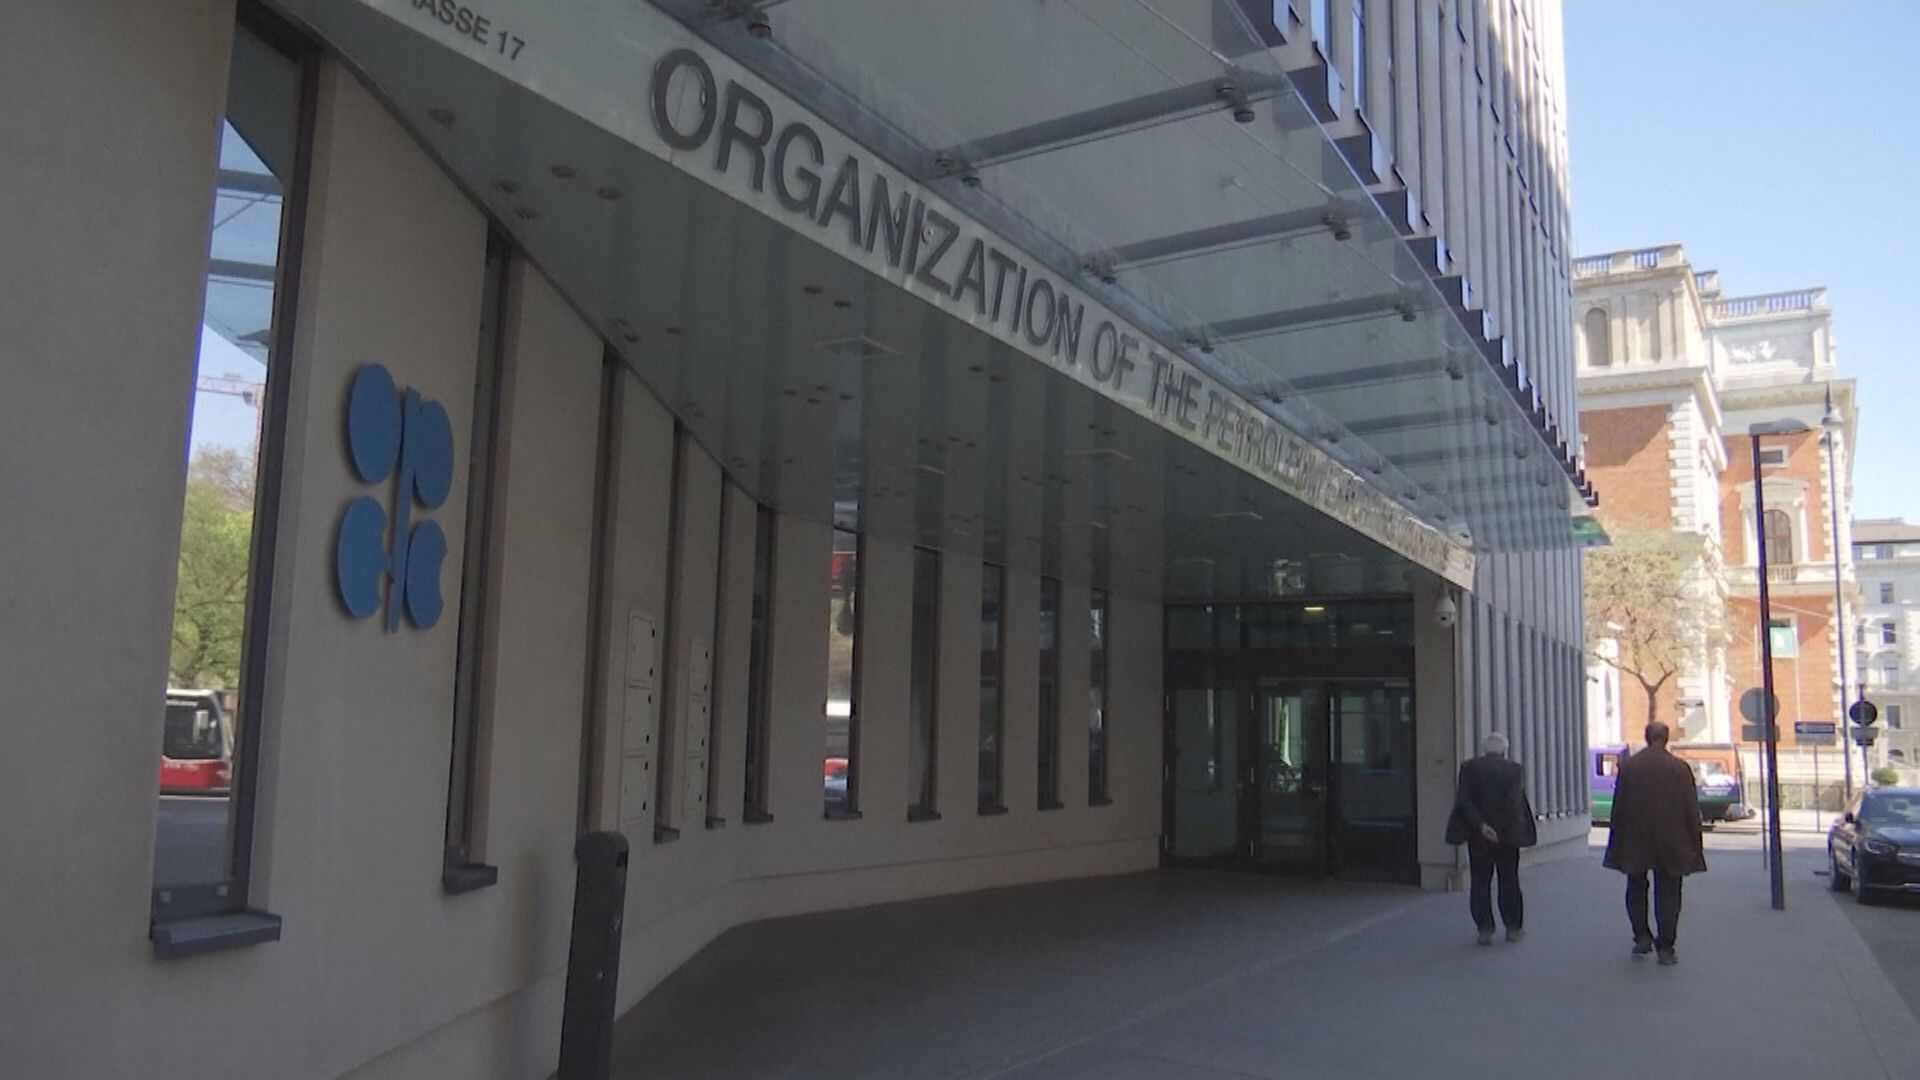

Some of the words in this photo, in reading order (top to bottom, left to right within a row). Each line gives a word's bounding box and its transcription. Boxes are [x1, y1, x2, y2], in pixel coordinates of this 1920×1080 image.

[498, 31, 526, 61] 17
[651, 47, 1085, 363] ORGANIZATION
[1090, 320, 1139, 391] OF
[1146, 351, 1202, 432] THE
